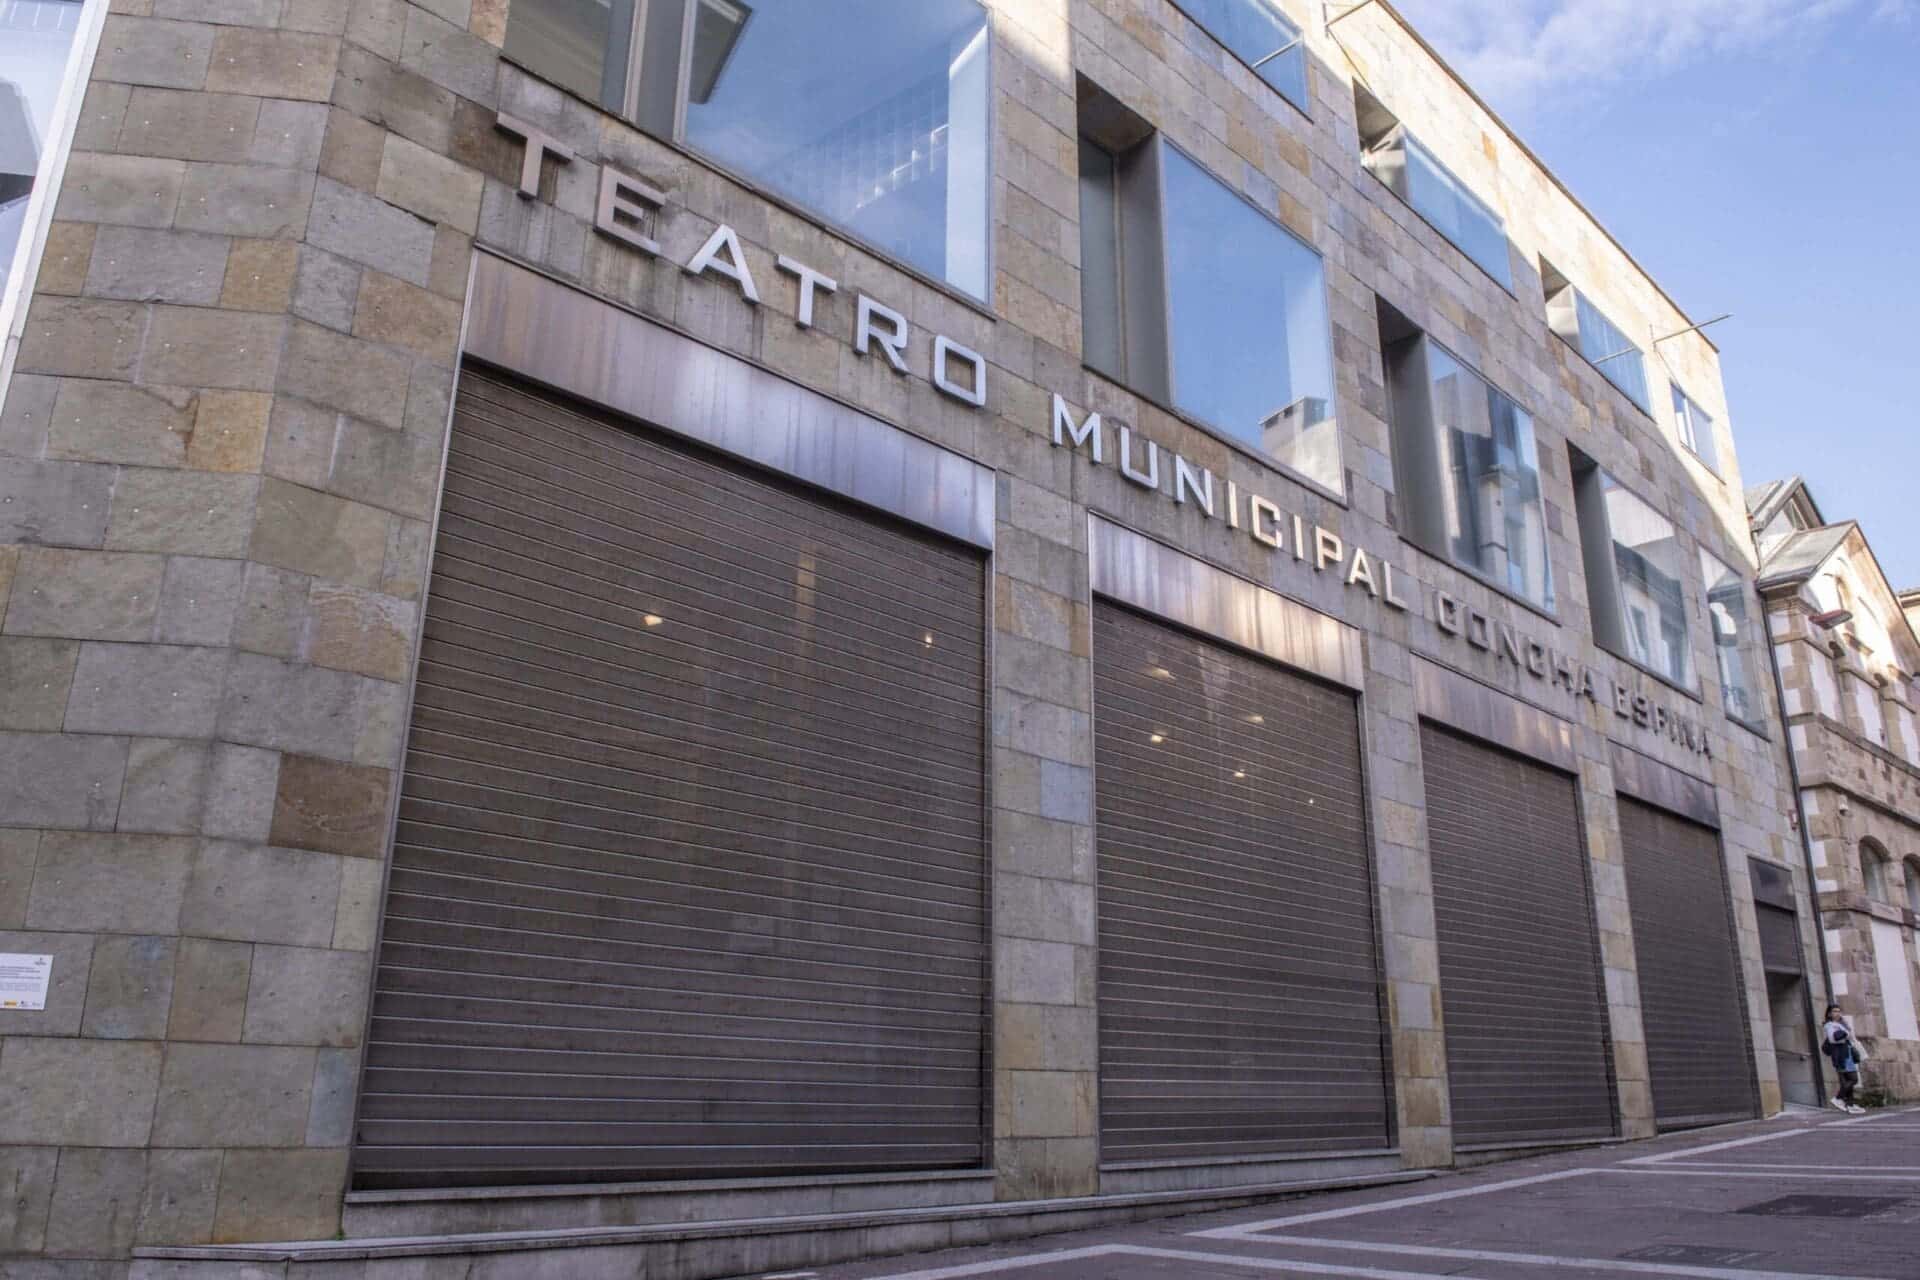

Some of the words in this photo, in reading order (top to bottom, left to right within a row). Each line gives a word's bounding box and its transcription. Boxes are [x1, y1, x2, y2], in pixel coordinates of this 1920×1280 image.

[496, 110, 987, 408] TEATRO
[1050, 392, 1408, 613] MUNICIPAL
[1436, 590, 1596, 702] CONCHA
[1611, 678, 1713, 758] ESPINA
